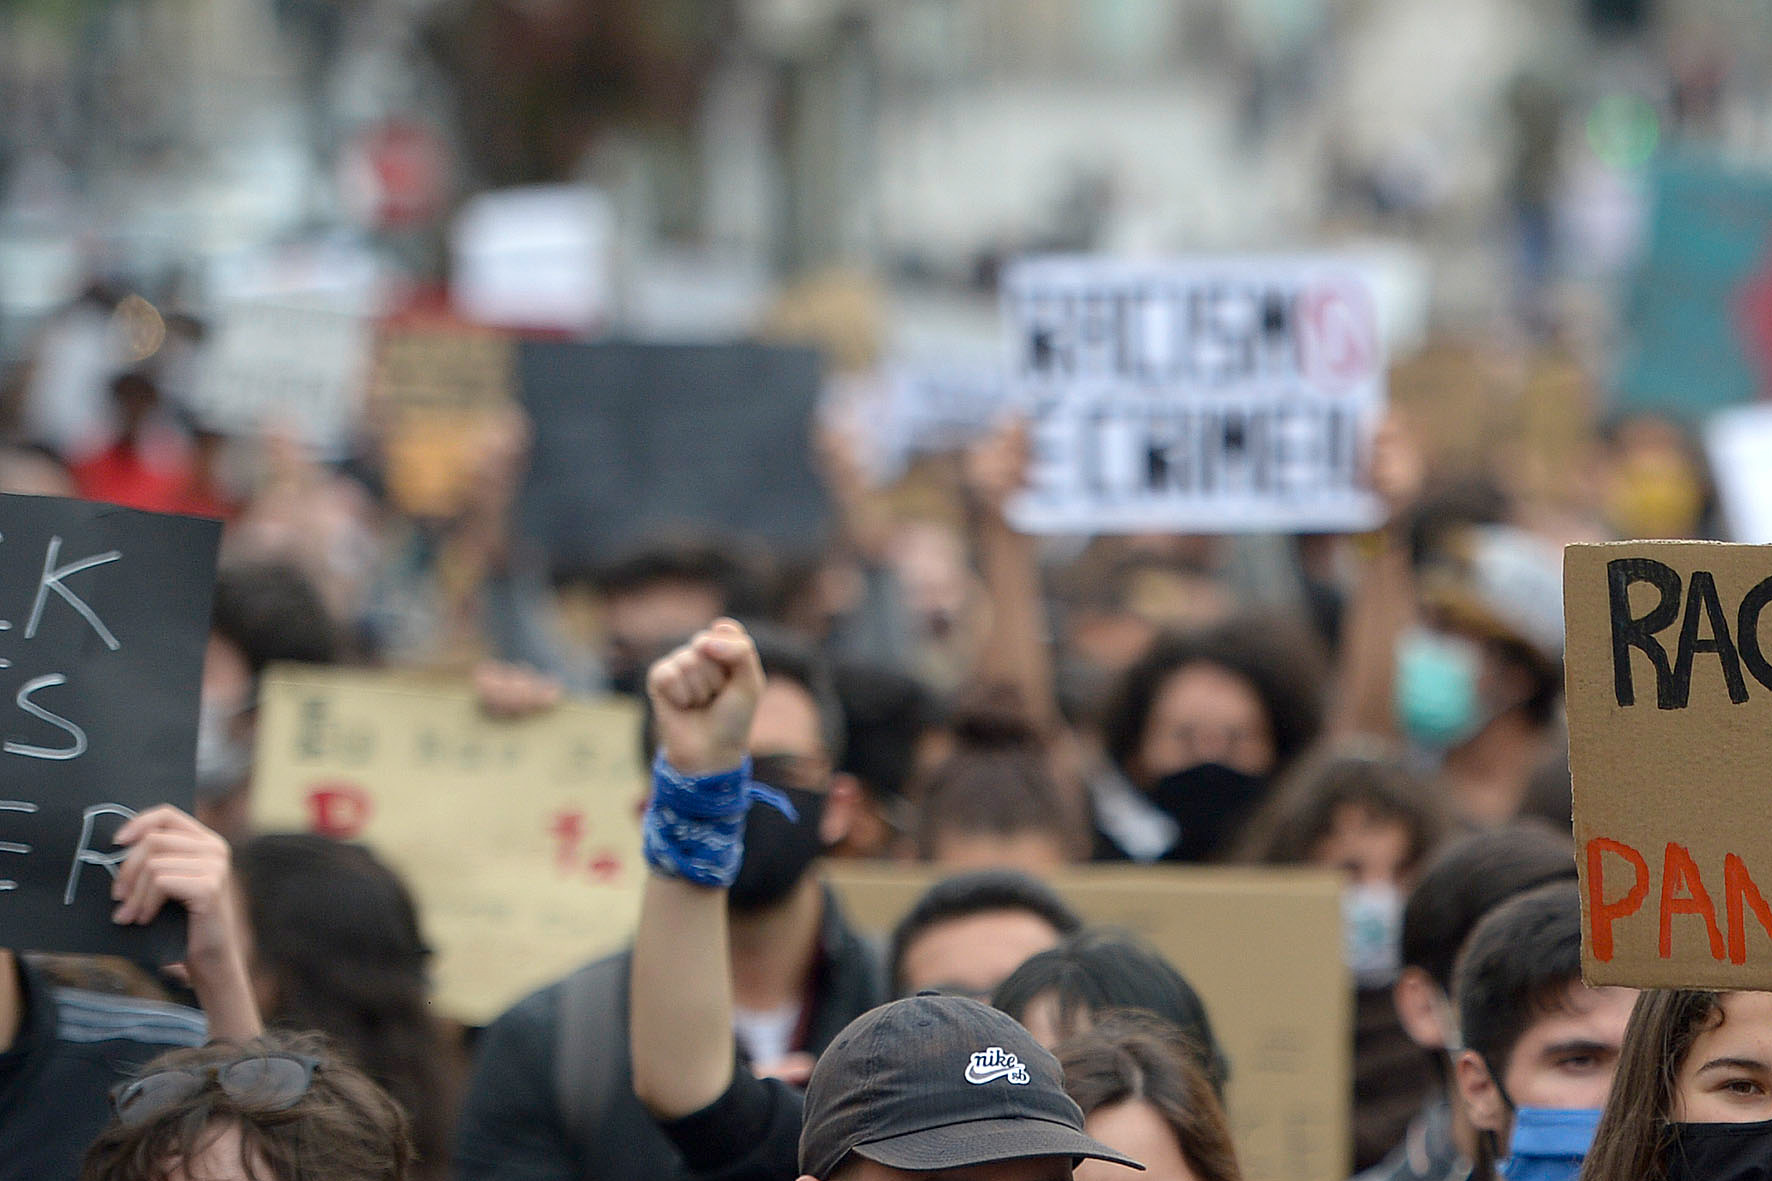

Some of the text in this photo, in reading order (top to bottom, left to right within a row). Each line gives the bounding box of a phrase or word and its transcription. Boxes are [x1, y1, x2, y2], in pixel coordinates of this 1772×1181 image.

[0, 534, 123, 651] K
[0, 656, 89, 760] S
[974, 1049, 1016, 1067] nike
